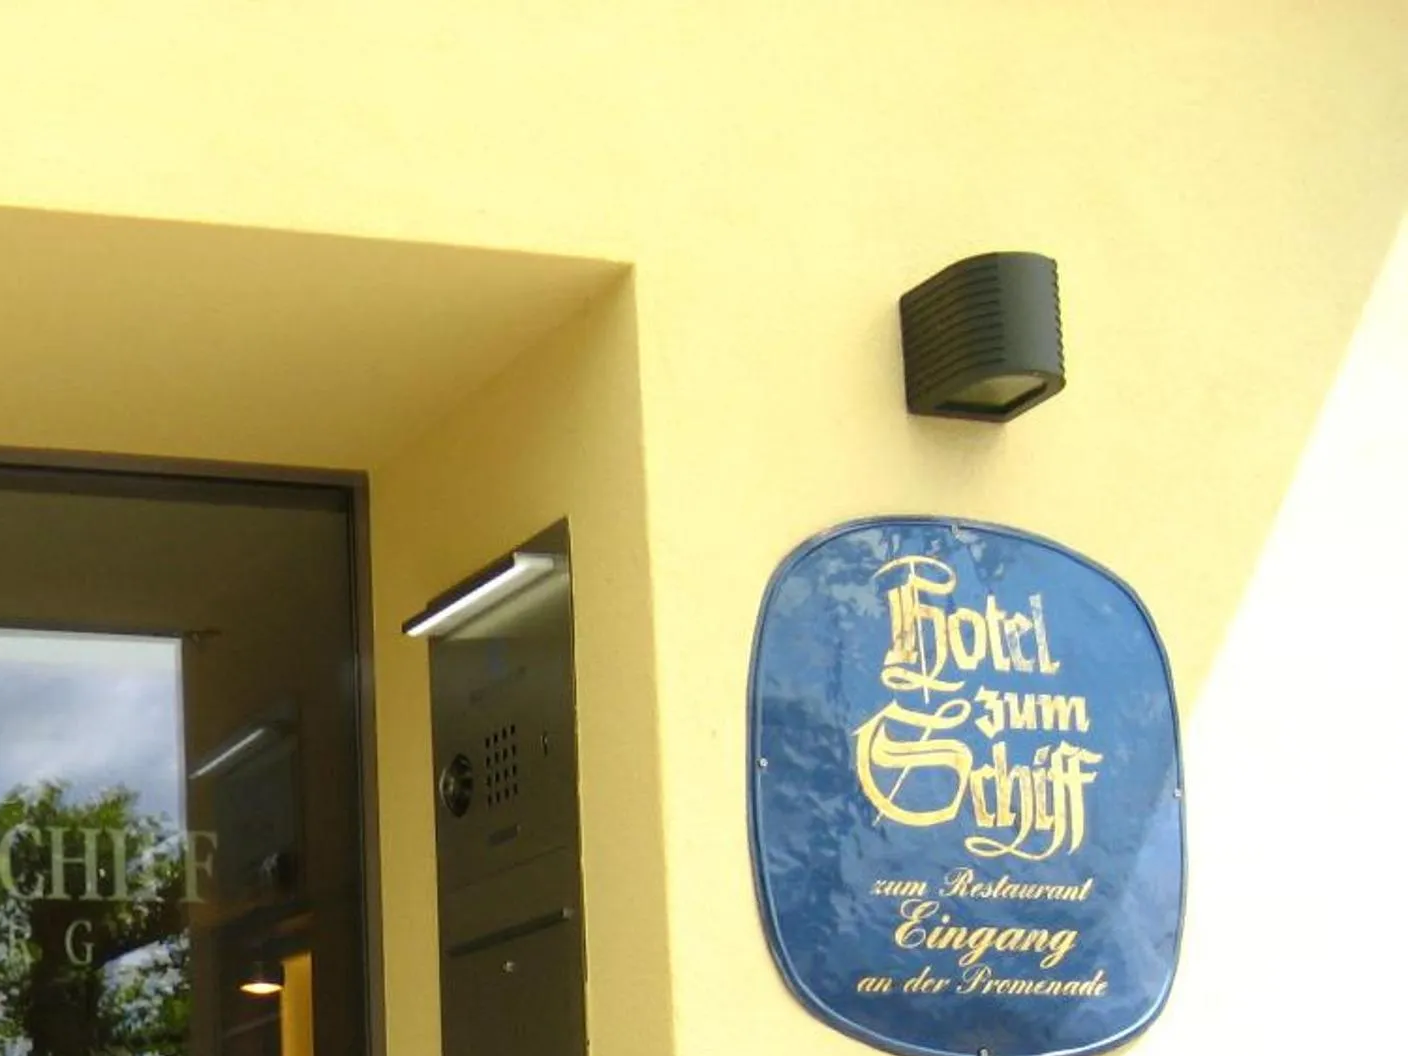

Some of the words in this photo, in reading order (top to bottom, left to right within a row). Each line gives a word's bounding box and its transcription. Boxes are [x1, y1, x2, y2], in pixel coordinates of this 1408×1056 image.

[873, 555, 1060, 704] Hotel
[974, 686, 1090, 738] zum
[851, 699, 1103, 861] Schiff
[871, 878, 928, 897] zum
[939, 866, 1094, 901] Restaurant
[894, 898, 1078, 969] Eingang
[857, 975, 892, 993] an
[903, 965, 950, 994] der
[956, 963, 1109, 997] Promenade
